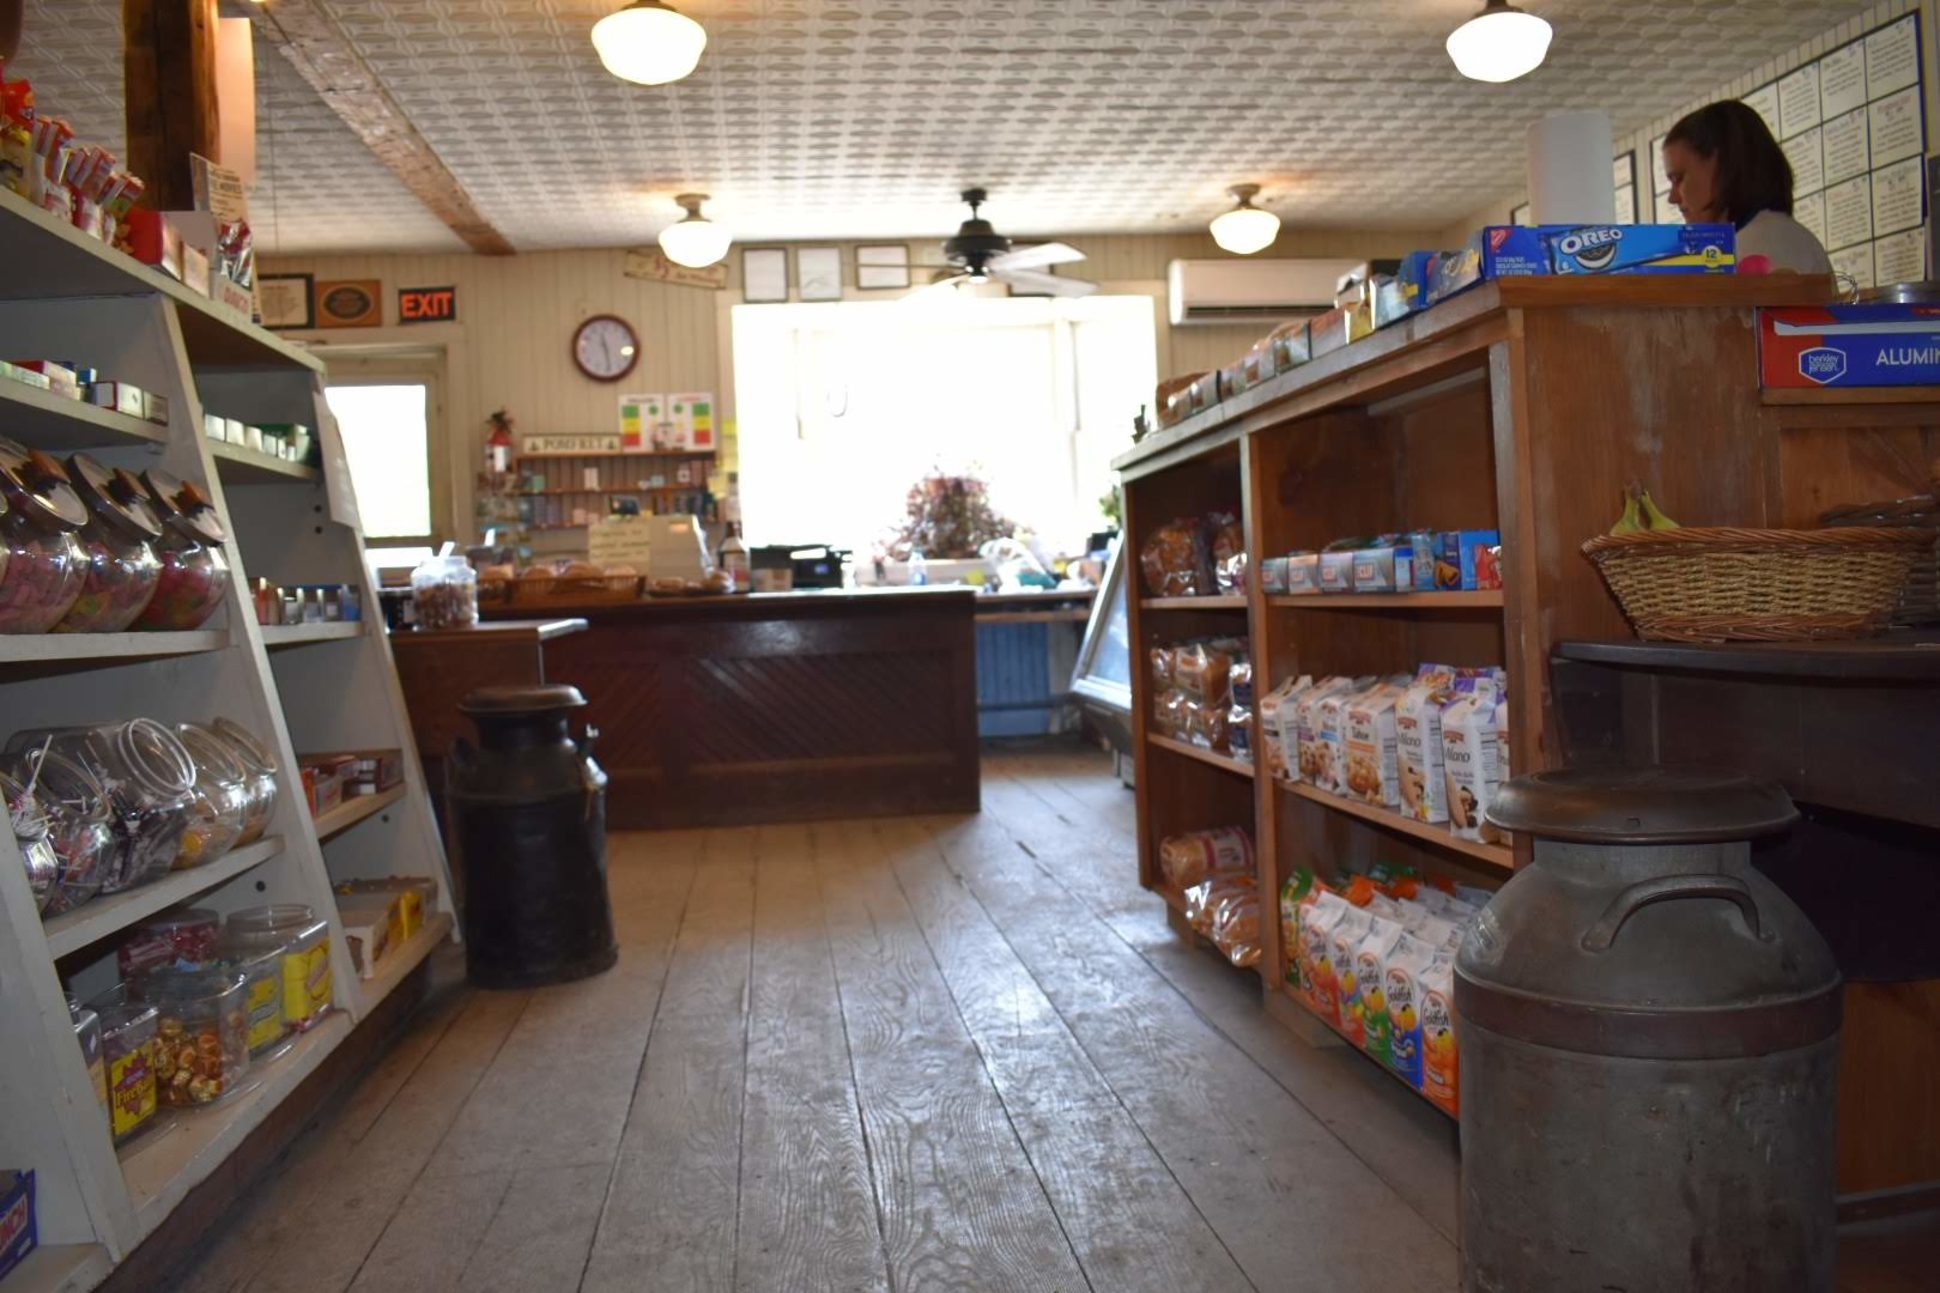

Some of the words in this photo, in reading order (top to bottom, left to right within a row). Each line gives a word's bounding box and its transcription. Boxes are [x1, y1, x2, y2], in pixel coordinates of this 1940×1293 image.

[1560, 229, 1623, 254] OREO
[1705, 248, 1717, 258] 12
[400, 292, 453, 318] EXIT
